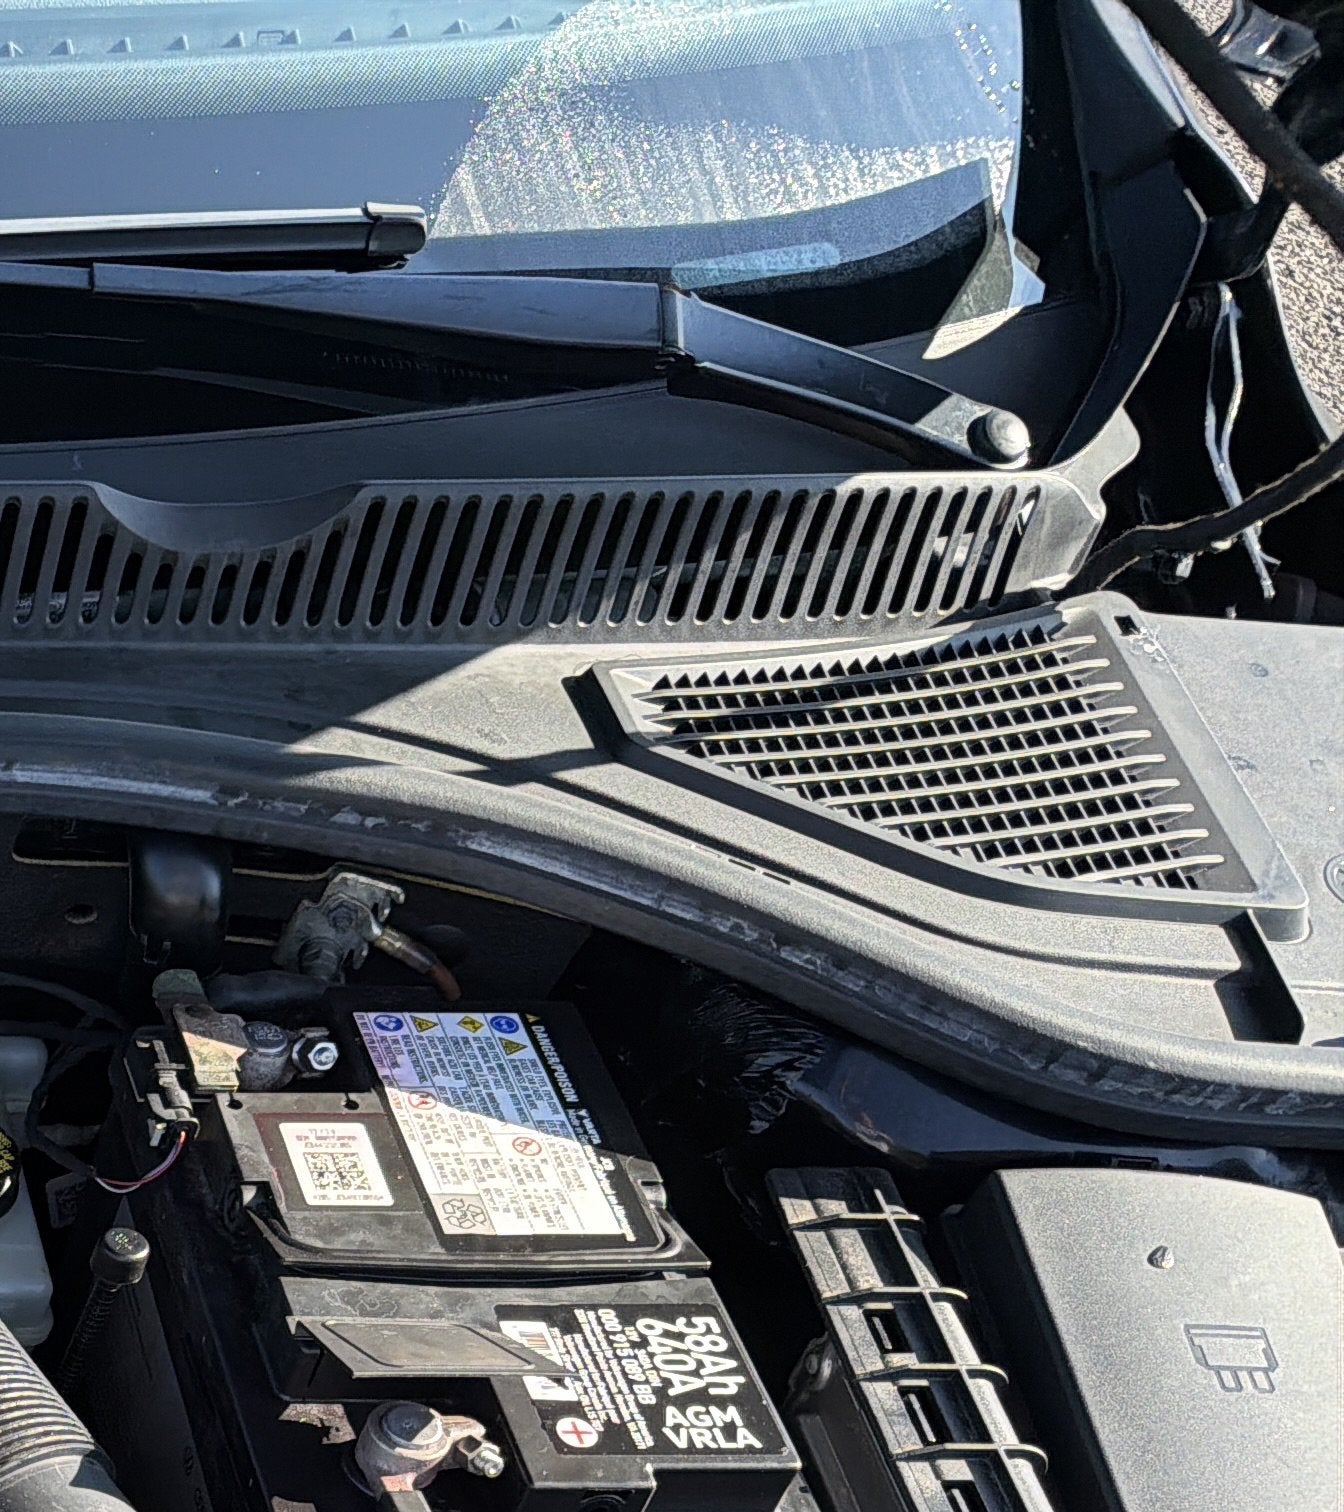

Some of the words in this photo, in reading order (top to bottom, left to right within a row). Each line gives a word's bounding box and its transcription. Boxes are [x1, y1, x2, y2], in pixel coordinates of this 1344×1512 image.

[532, 1025, 579, 1103] DANGER/POISON
[595, 1308, 623, 1331] 000
[608, 1333, 635, 1356] 915
[676, 1316, 746, 1395] 58Ah
[636, 1318, 706, 1396] 640A
[620, 1358, 646, 1381] 089
[665, 1406, 744, 1427] AGM
[662, 1427, 763, 1449] VRLA
